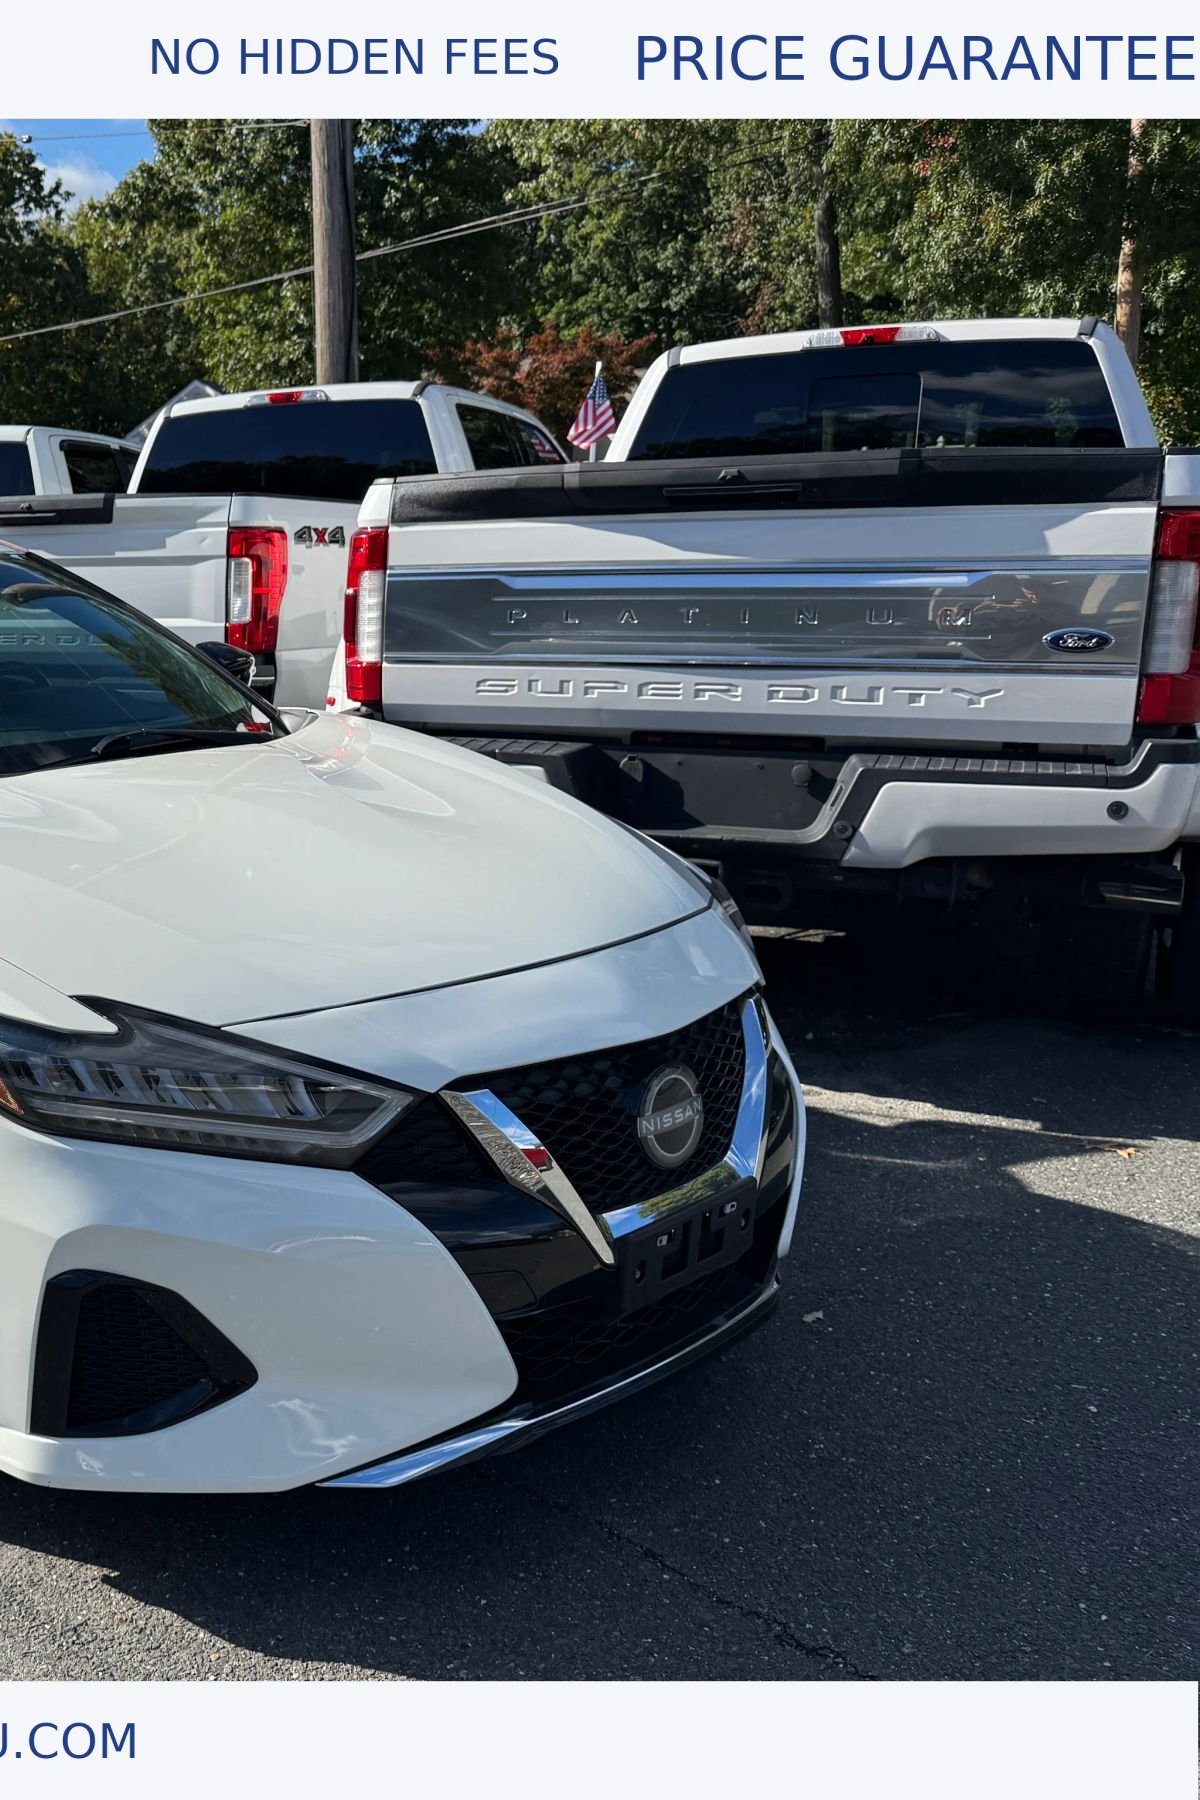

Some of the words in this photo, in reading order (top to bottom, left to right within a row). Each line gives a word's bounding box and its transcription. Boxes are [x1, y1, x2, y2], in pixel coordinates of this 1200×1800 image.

[507, 608, 972, 626] PLATINUM
[1060, 633, 1098, 647] Ford
[475, 678, 742, 701] SUPER
[767, 684, 1004, 708] DUTY
[642, 1101, 701, 1134] NISSAN
